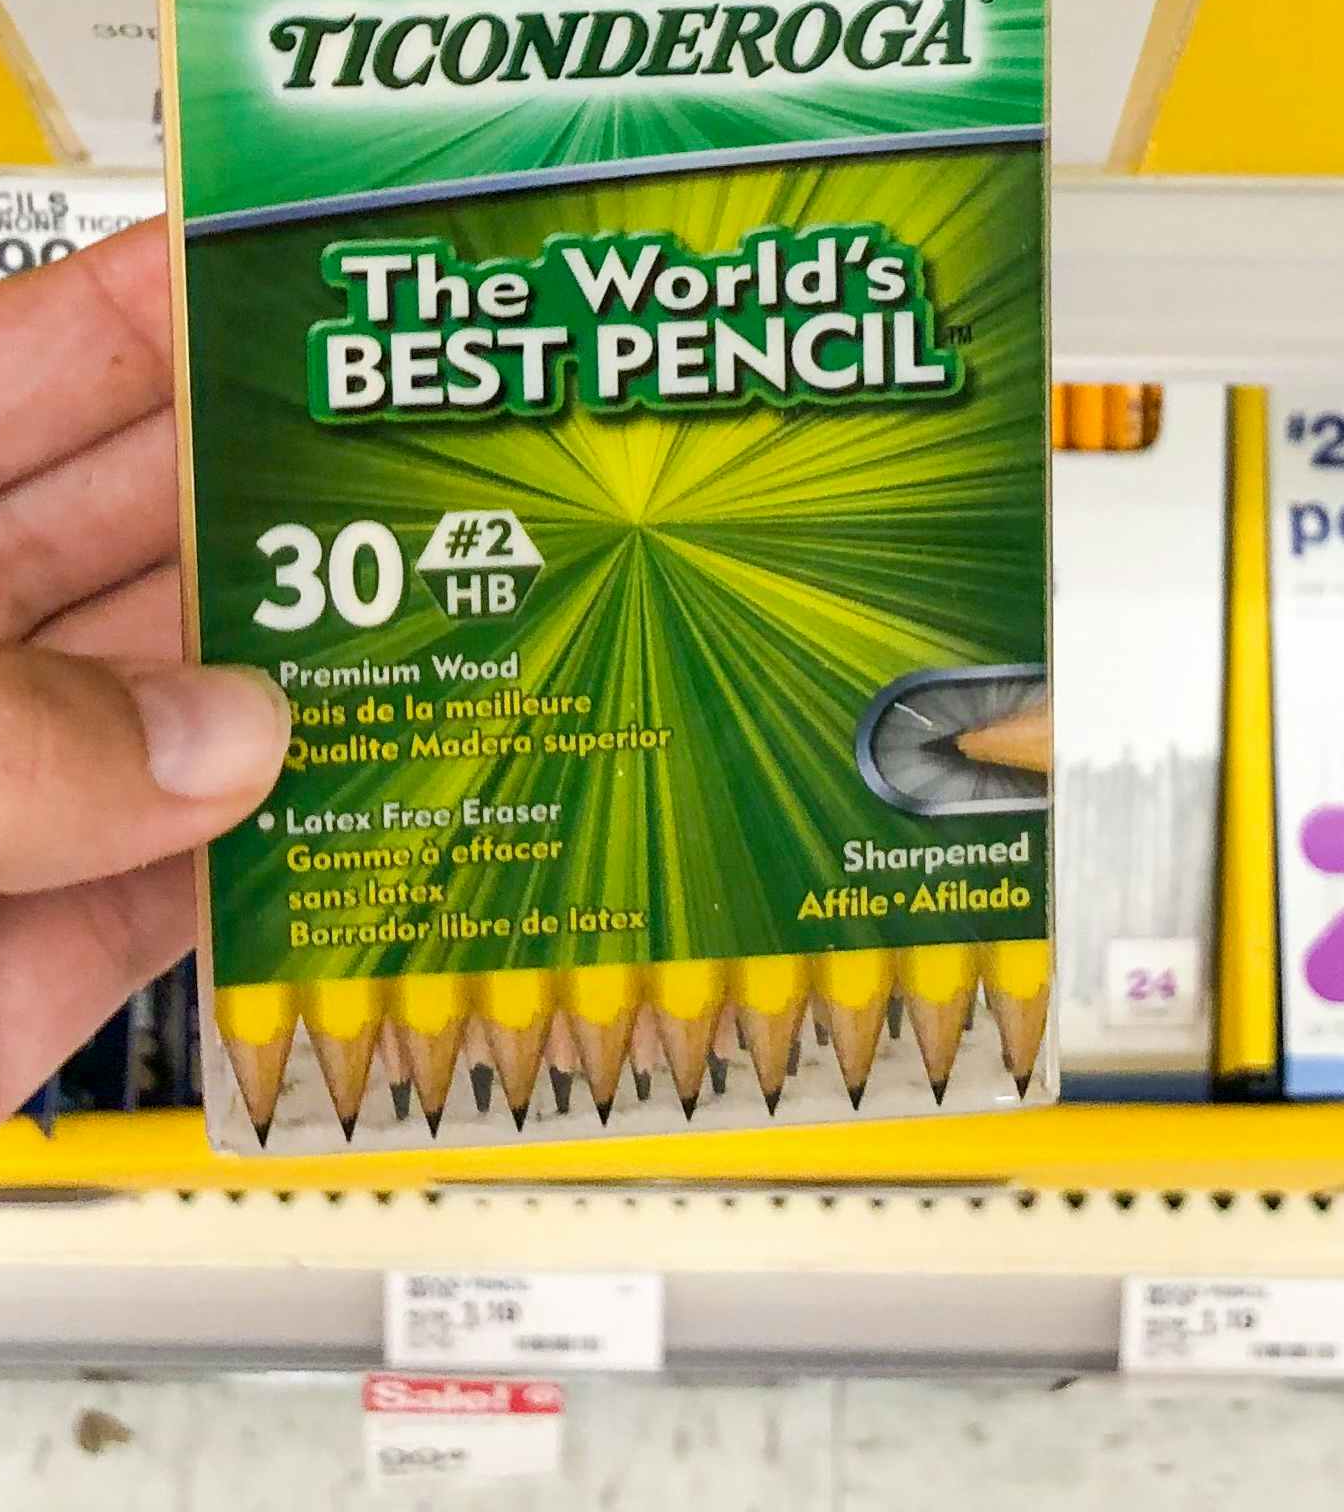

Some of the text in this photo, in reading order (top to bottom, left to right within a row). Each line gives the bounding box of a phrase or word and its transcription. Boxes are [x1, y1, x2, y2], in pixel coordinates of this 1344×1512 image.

[342, 240, 905, 323] The World's
[327, 312, 946, 410] BEST PENCIL
[445, 517, 514, 558] #2
[253, 519, 405, 631] 30
[446, 575, 518, 617] HB
[279, 651, 520, 688] Premium Wood
[356, 695, 394, 725] de
[405, 694, 434, 721] la
[446, 688, 592, 718] meilleure
[285, 722, 672, 772] Qualite Madera superior
[286, 797, 563, 836] Latex Free Eraser
[286, 834, 564, 874] Gomme à effacer
[843, 834, 1031, 876] Sharpened
[289, 879, 446, 911] sans latex
[290, 915, 431, 949] Borrador
[441, 910, 510, 940] libre
[522, 907, 559, 936] de
[1126, 967, 1177, 1000] 24
